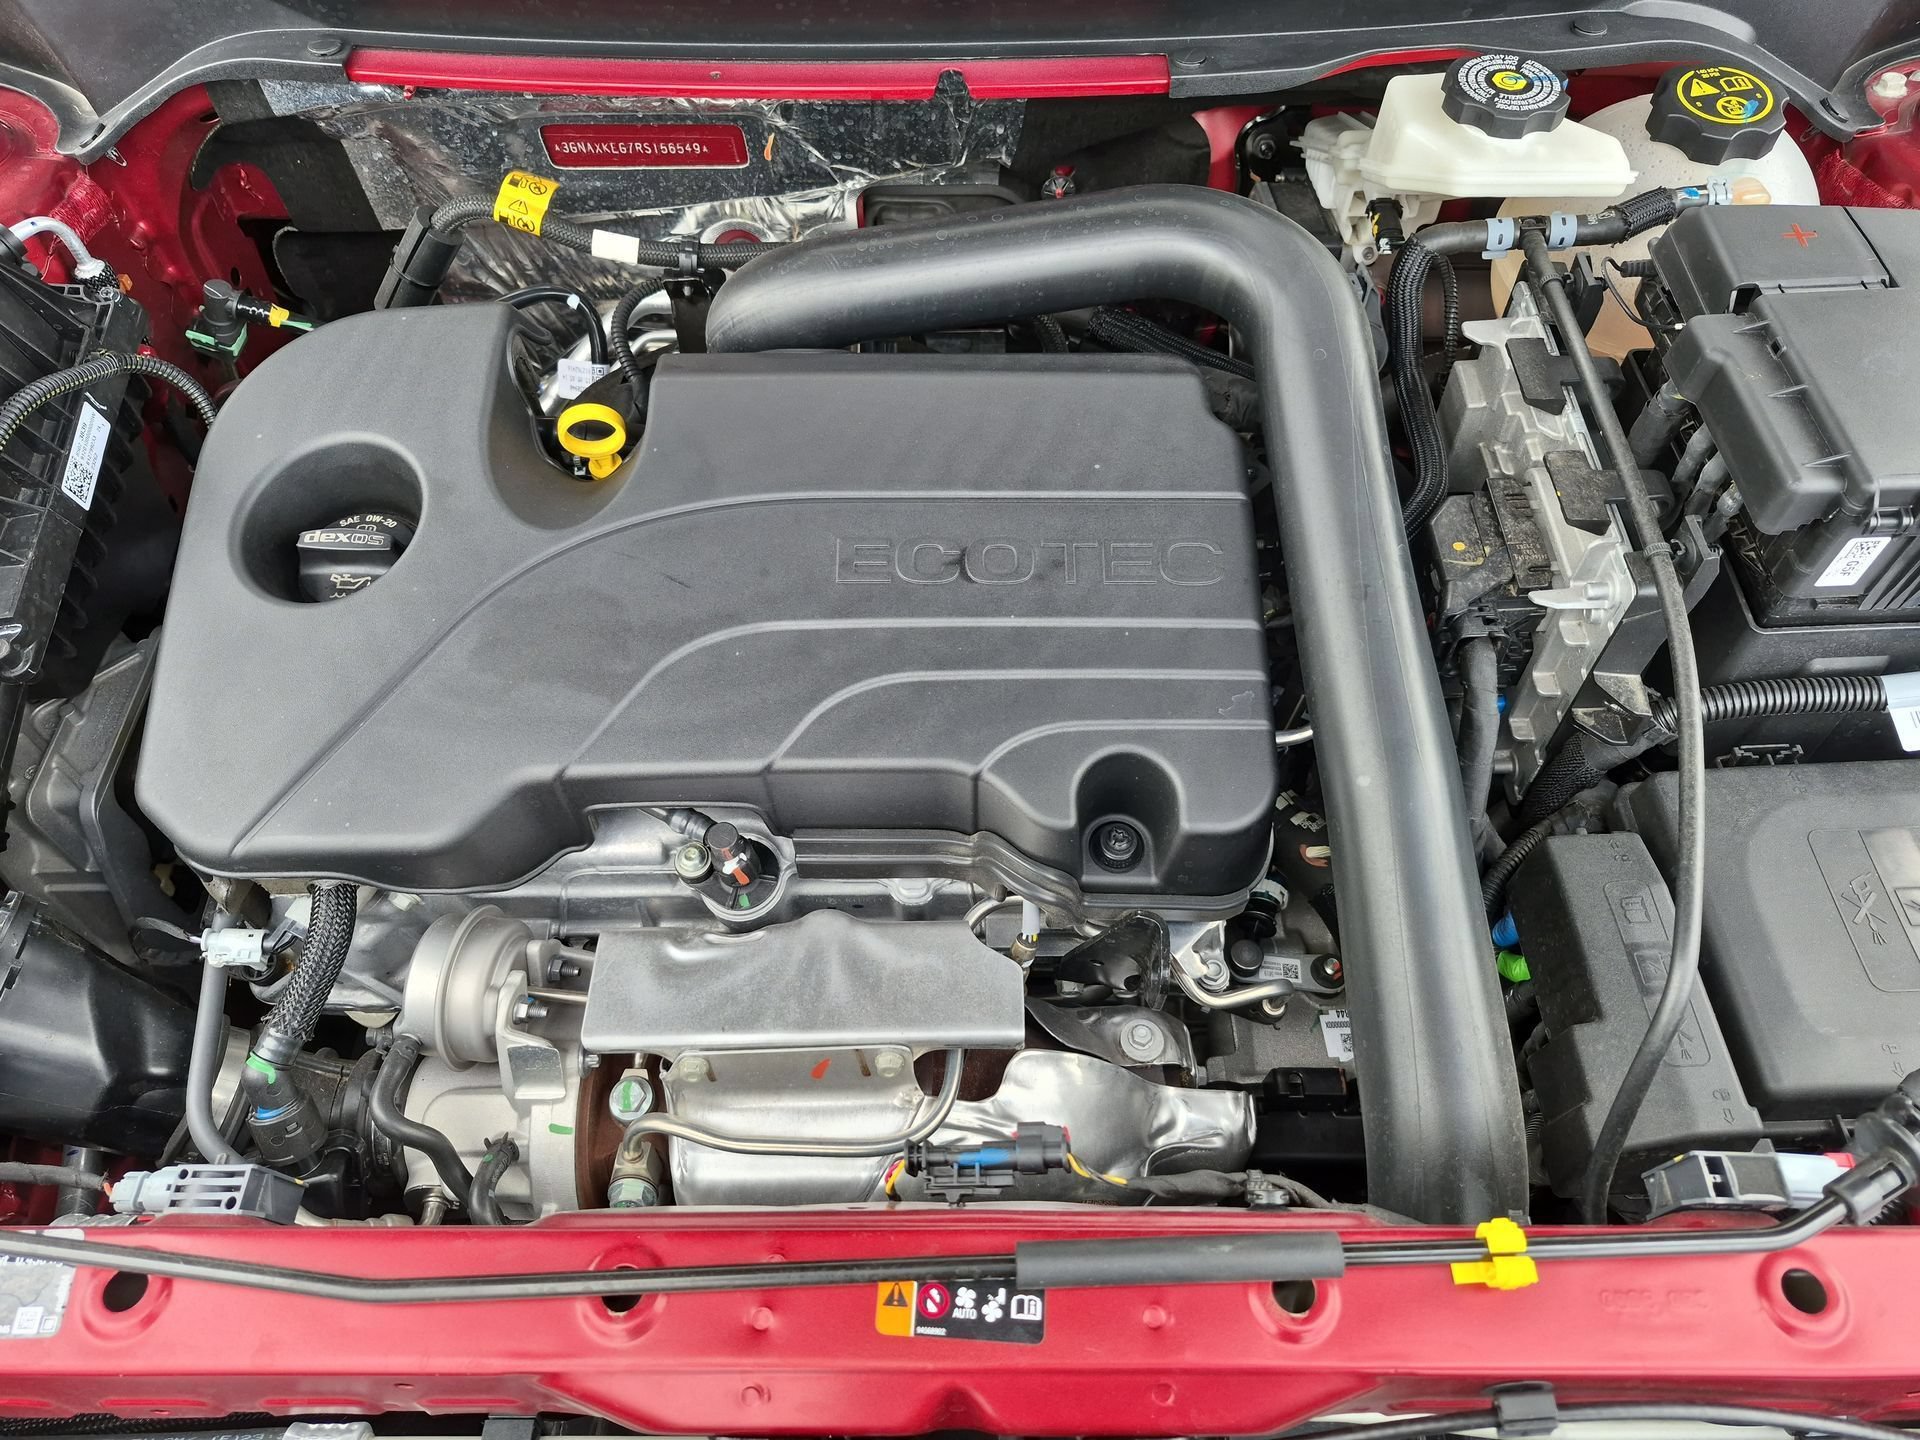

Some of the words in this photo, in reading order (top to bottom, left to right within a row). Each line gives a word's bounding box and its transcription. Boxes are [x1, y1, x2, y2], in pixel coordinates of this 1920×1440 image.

[339, 515, 361, 527] SAE
[365, 514, 398, 528] 0W-20
[303, 530, 385, 546] dexos
[835, 538, 1225, 586] ECOTEC
[952, 1307, 977, 1319] AUTO
